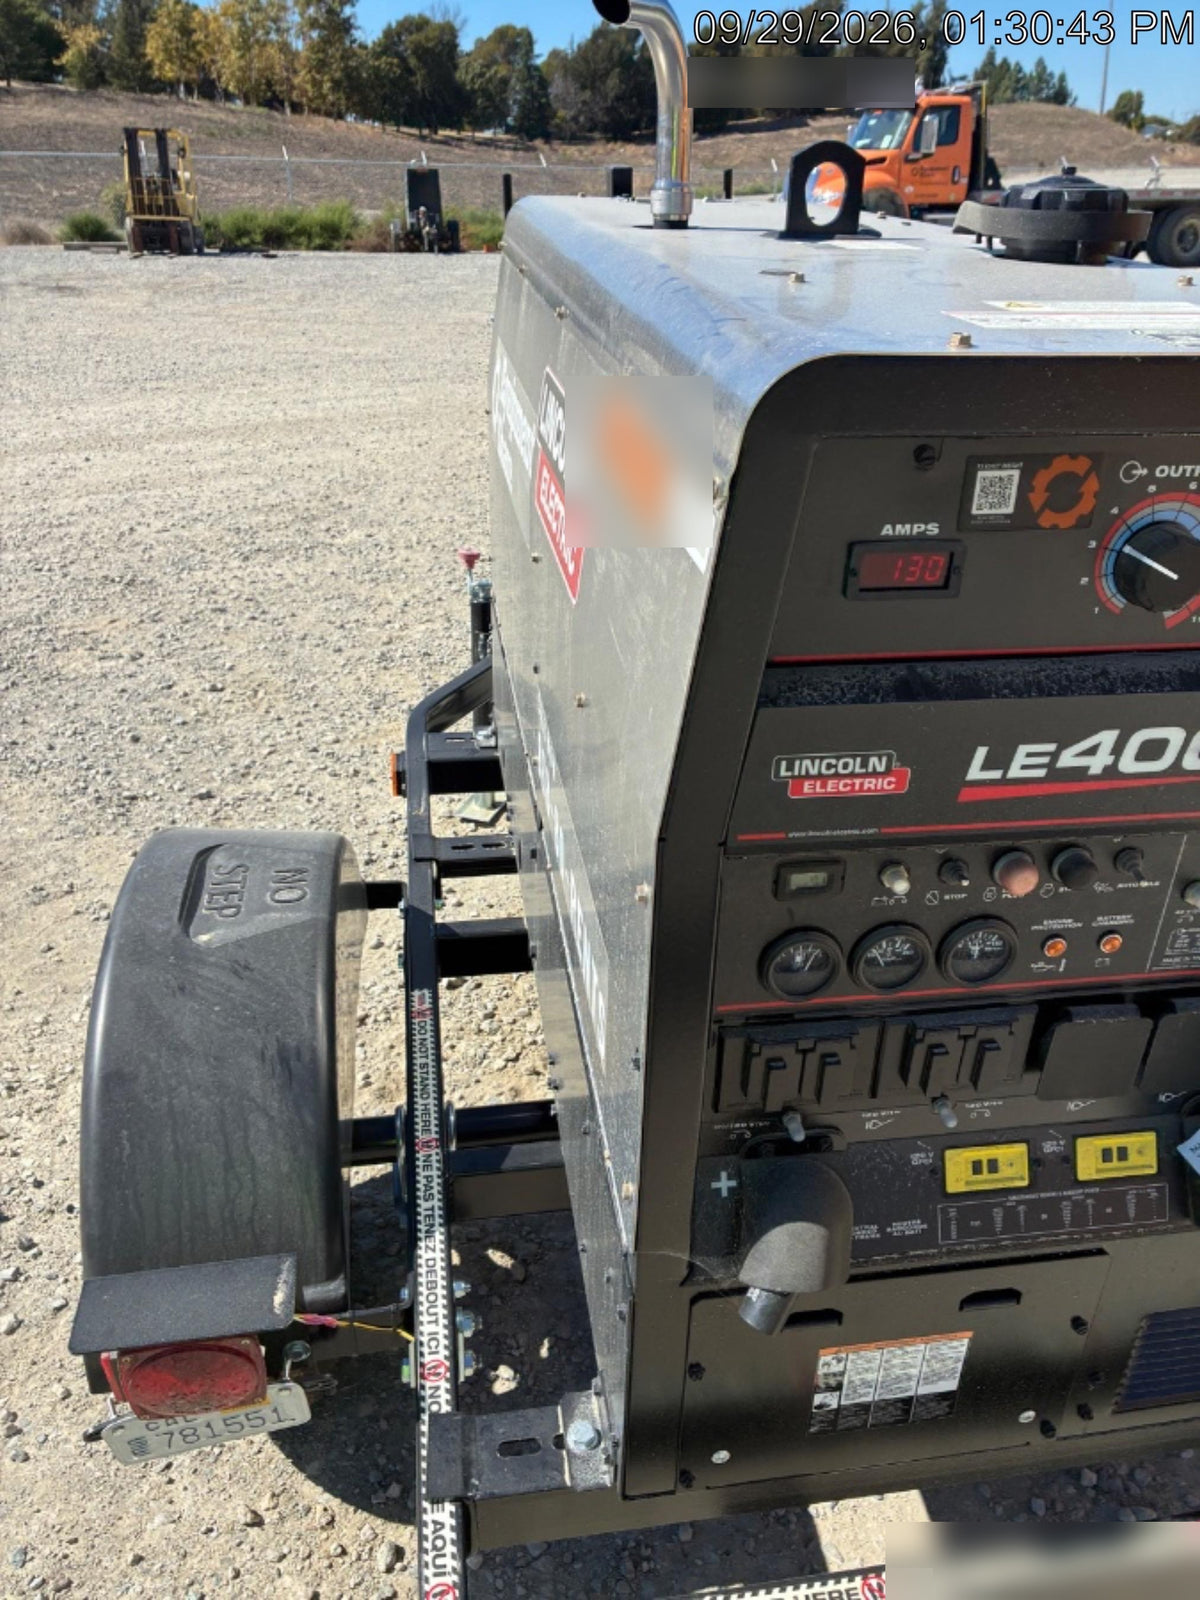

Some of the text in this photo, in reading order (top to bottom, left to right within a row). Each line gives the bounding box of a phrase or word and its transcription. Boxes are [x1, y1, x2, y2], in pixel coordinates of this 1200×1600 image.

[1110, 506, 1120, 515] 4
[881, 521, 941, 537] AMPS
[1088, 540, 1097, 549] 3
[893, 555, 945, 583] 130
[1080, 577, 1089, 585] 2
[1094, 606, 1099, 614] 1
[778, 755, 888, 778] LINCOLN
[803, 778, 896, 797] ELECTRIC
[202, 863, 250, 919] STEP
[267, 866, 311, 905] NO
[417, 1020, 428, 1036] DO
[418, 1038, 428, 1060] NOT
[418, 1062, 430, 1101] STAND
[420, 1104, 432, 1137] HERE
[422, 1154, 440, 1356] NE PAS TENEZ DEBOUT ICI
[156, 1407, 286, 1448] 781551
